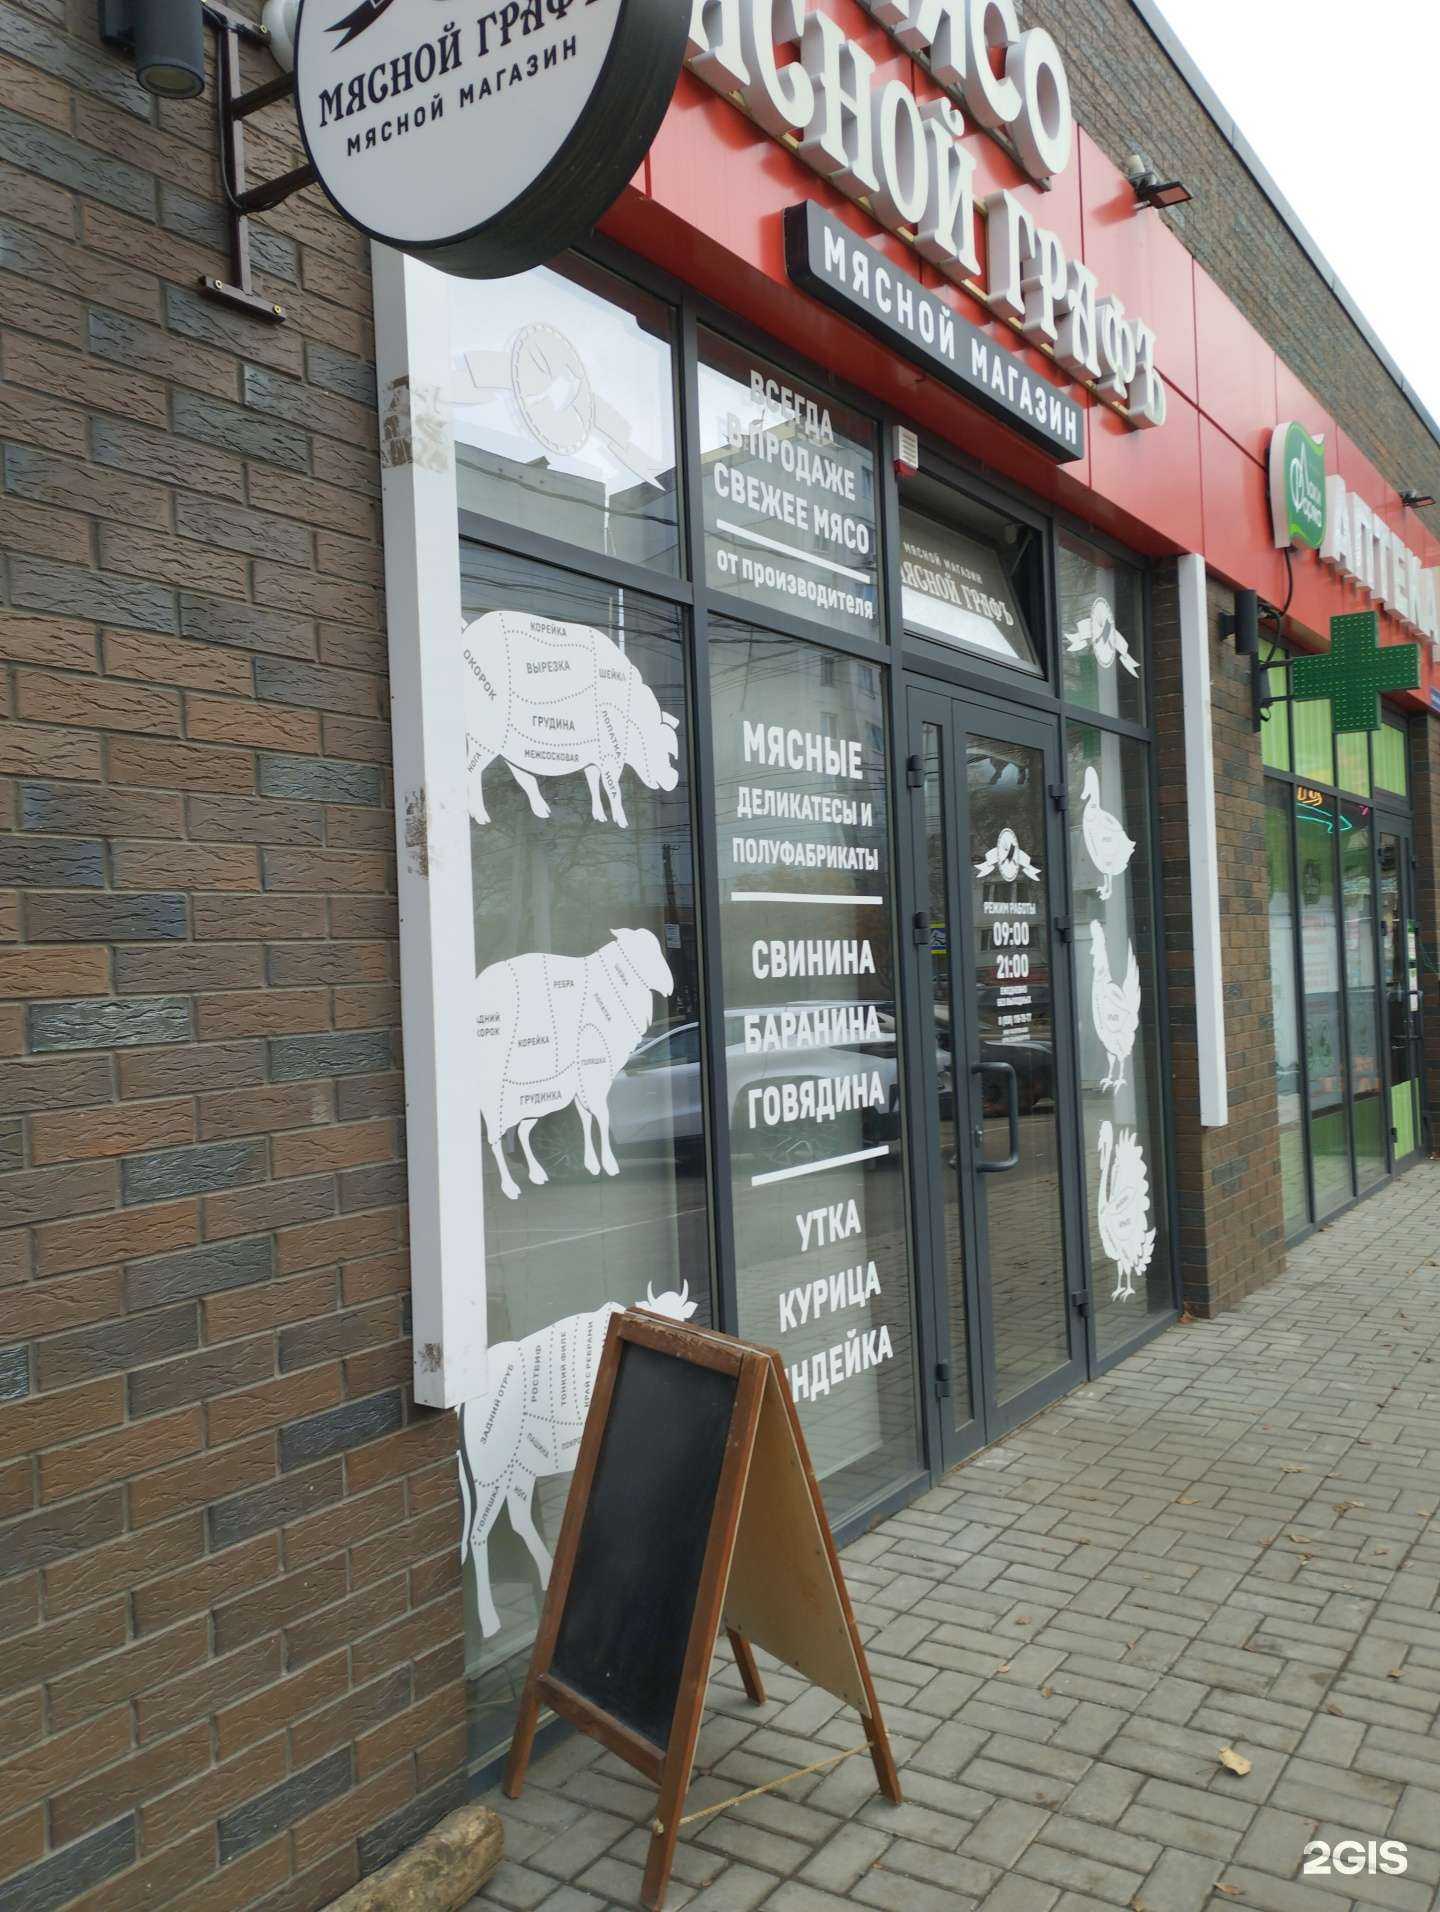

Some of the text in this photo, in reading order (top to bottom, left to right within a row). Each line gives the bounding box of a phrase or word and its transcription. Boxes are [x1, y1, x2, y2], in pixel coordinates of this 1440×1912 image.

[318, 22, 463, 128] МЯСНОЙ
[347, 35, 577, 156] МЯСНОЙ МАГАЗИН
[1002, 189, 1167, 426] ГРАФЪ
[823, 225, 1077, 445] МЯСНОЙ МАГАЗИН
[750, 370, 833, 443] ВСЕГДА
[726, 412, 856, 502] В ПРОДАЖЕ
[713, 462, 870, 555] СВЕЖЕЕ МЯСО
[1322, 474, 1440, 650] АПТЕК
[530, 621, 567, 637] КОРЕЙКА
[961, 585, 1014, 626] ГРАФЪ
[463, 649, 496, 701] ОКОРОК
[526, 661, 571, 674] ВЫРЕЗКА
[532, 716, 575, 731] ГРУДИНА
[743, 721, 863, 780] МЯСНЫЕ
[737, 787, 873, 827] ДЕЛИКАТЕСЫ И
[732, 837, 879, 871] ПОЛУФАБРИКАТЫ
[752, 940, 875, 979] СВИНИНА
[993, 921, 1029, 946] 09:00
[996, 954, 1029, 979] 21:00
[476, 1011, 501, 1024] ДНИЙ
[744, 1006, 880, 1053] БАРАНИНА
[748, 1071, 885, 1128] ГОВЯДИНА
[796, 1199, 862, 1252] УТКА
[778, 1261, 881, 1332] КУРИЦА
[785, 1325, 893, 1403] НДЕЙКА
